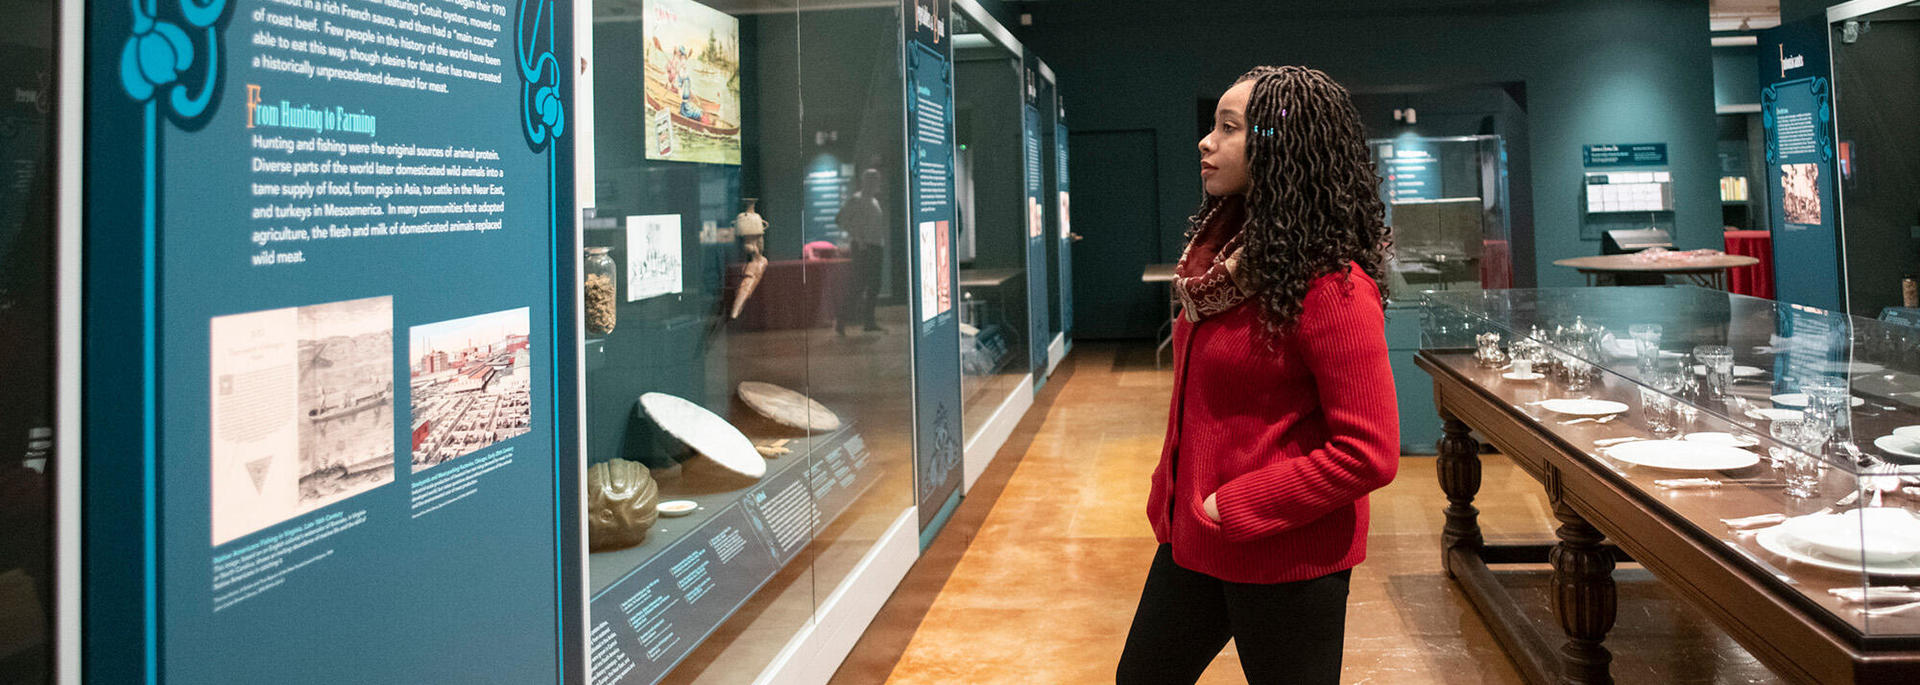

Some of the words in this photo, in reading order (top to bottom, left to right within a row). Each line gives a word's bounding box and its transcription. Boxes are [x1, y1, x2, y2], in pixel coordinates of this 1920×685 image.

[420, 3, 442, 18] Cotuit
[443, 11, 469, 25] oysters,
[470, 18, 492, 30] moved
[492, 23, 501, 32] on
[476, 0, 491, 12] their
[492, 4, 506, 16] 1910
[253, 8, 265, 21] of
[267, 13, 293, 27] roast
[294, 14, 320, 32] beef.
[324, 21, 344, 36] Few
[345, 29, 375, 44] people
[377, 31, 385, 43] in
[386, 34, 400, 47] the
[401, 36, 426, 55] history
[427, 42, 436, 54] of
[436, 44, 448, 56] the
[449, 48, 468, 60] world
[469, 50, 484, 63] have
[485, 53, 501, 66] been
[305, 0, 313, 9] in
[315, 3, 321, 11] a
[323, 1, 340, 15] rich
[341, 4, 371, 21] French
[372, 14, 397, 29] sauce,
[399, 19, 413, 30] and
[415, 21, 431, 34] then
[432, 24, 446, 37] had
[447, 31, 452, 39] a
[453, 29, 473, 43] "main
[473, 37, 497, 48] course"
[253, 31, 276, 47] able
[277, 36, 289, 49] to
[291, 41, 307, 52] eat
[309, 40, 327, 55] this
[328, 47, 348, 61] way,
[349, 47, 380, 66] though
[382, 53, 406, 68] desire
[407, 56, 418, 70] for
[420, 60, 434, 73] that
[435, 62, 449, 75] diet
[451, 64, 462, 77] has
[463, 70, 477, 79] now
[478, 72, 501, 84] created
[252, 57, 260, 67] a
[262, 53, 315, 78] historically
[316, 66, 382, 84] unprecedented
[384, 72, 415, 88] demand
[417, 77, 427, 89] for
[428, 83, 449, 93] meat.
[246, 84, 279, 128] From
[281, 100, 323, 133] Hunting
[325, 107, 335, 130] to
[336, 106, 376, 137] Farming
[252, 134, 294, 154] Hunting
[296, 138, 315, 151] and
[316, 137, 347, 156] fishing
[347, 143, 370, 154] were
[371, 141, 385, 155] the
[387, 143, 415, 159] original
[417, 147, 443, 157] sources
[445, 146, 453, 158] of
[453, 147, 475, 159] animal
[476, 149, 500, 162] protein.
[252, 157, 292, 172] Diverse
[294, 161, 319, 177] parts
[320, 160, 331, 173] of
[332, 160, 349, 173] the
[349, 161, 374, 174] world
[375, 161, 394, 175] later
[395, 162, 445, 176] domesticated
[446, 165, 460, 176] wild
[461, 165, 485, 177] animals
[486, 167, 498, 177] into
[499, 169, 504, 178] a
[252, 182, 280, 195] tame
[281, 180, 315, 199] supply
[316, 180, 327, 195] of
[328, 180, 353, 197] food,
[353, 181, 375, 195] from
[376, 183, 393, 199] pigs
[395, 183, 402, 195] in
[403, 183, 422, 197] Asia,
[423, 184, 432, 195] to
[432, 183, 453, 195] cattle
[453, 183, 460, 195] in
[461, 183, 472, 195] the
[473, 184, 489, 195] Near
[490, 184, 505, 197] East,
[252, 204, 273, 218] and
[275, 203, 312, 221] turkeys
[314, 204, 322, 217] in
[323, 203, 385, 217] Mesoamerica.
[387, 202, 397, 215] In
[397, 205, 418, 218] many
[419, 201, 463, 214] communities
[464, 201, 477, 213] that
[478, 201, 504, 215] adopted
[252, 226, 310, 246] agriculture,
[311, 225, 328, 239] the
[329, 223, 351, 238] flesh
[352, 223, 369, 237] and
[371, 222, 388, 236] milk
[389, 221, 398, 235] of
[399, 220, 449, 234] domesticated
[450, 219, 474, 232] animals
[475, 218, 502, 234] replaced
[252, 250, 275, 265] wild
[277, 250, 306, 264] meat.
